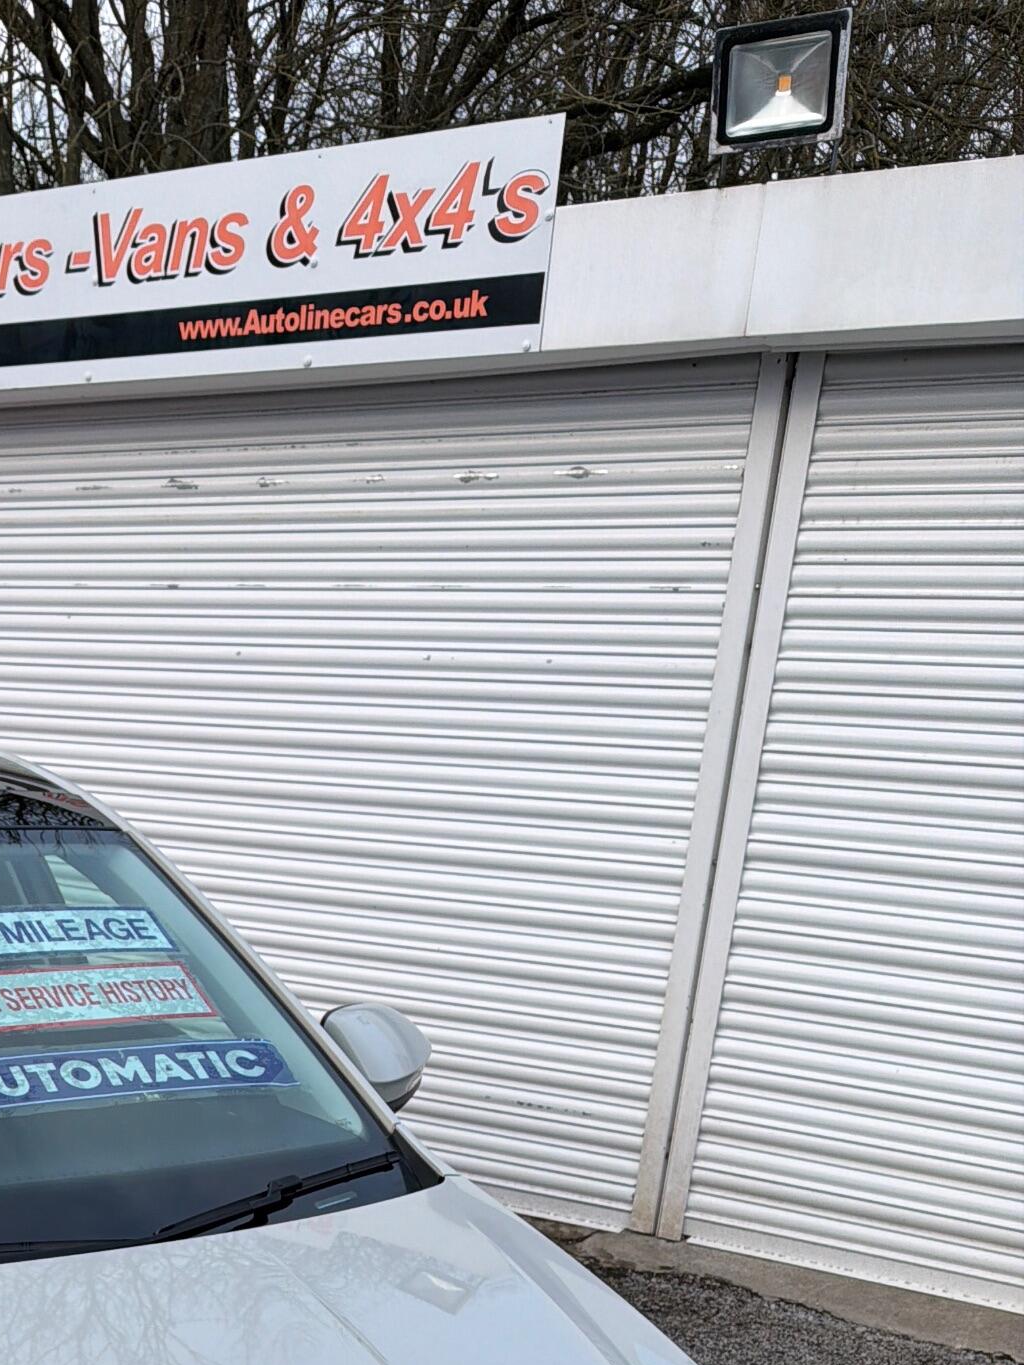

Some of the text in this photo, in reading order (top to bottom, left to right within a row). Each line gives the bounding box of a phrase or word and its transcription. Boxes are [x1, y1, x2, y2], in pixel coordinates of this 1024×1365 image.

[266, 183, 319, 267] &
[178, 289, 488, 342] www.Autolinecars.co.uk
[0, 983, 102, 1012] SERVICE
[98, 977, 194, 1006] HISTORY
